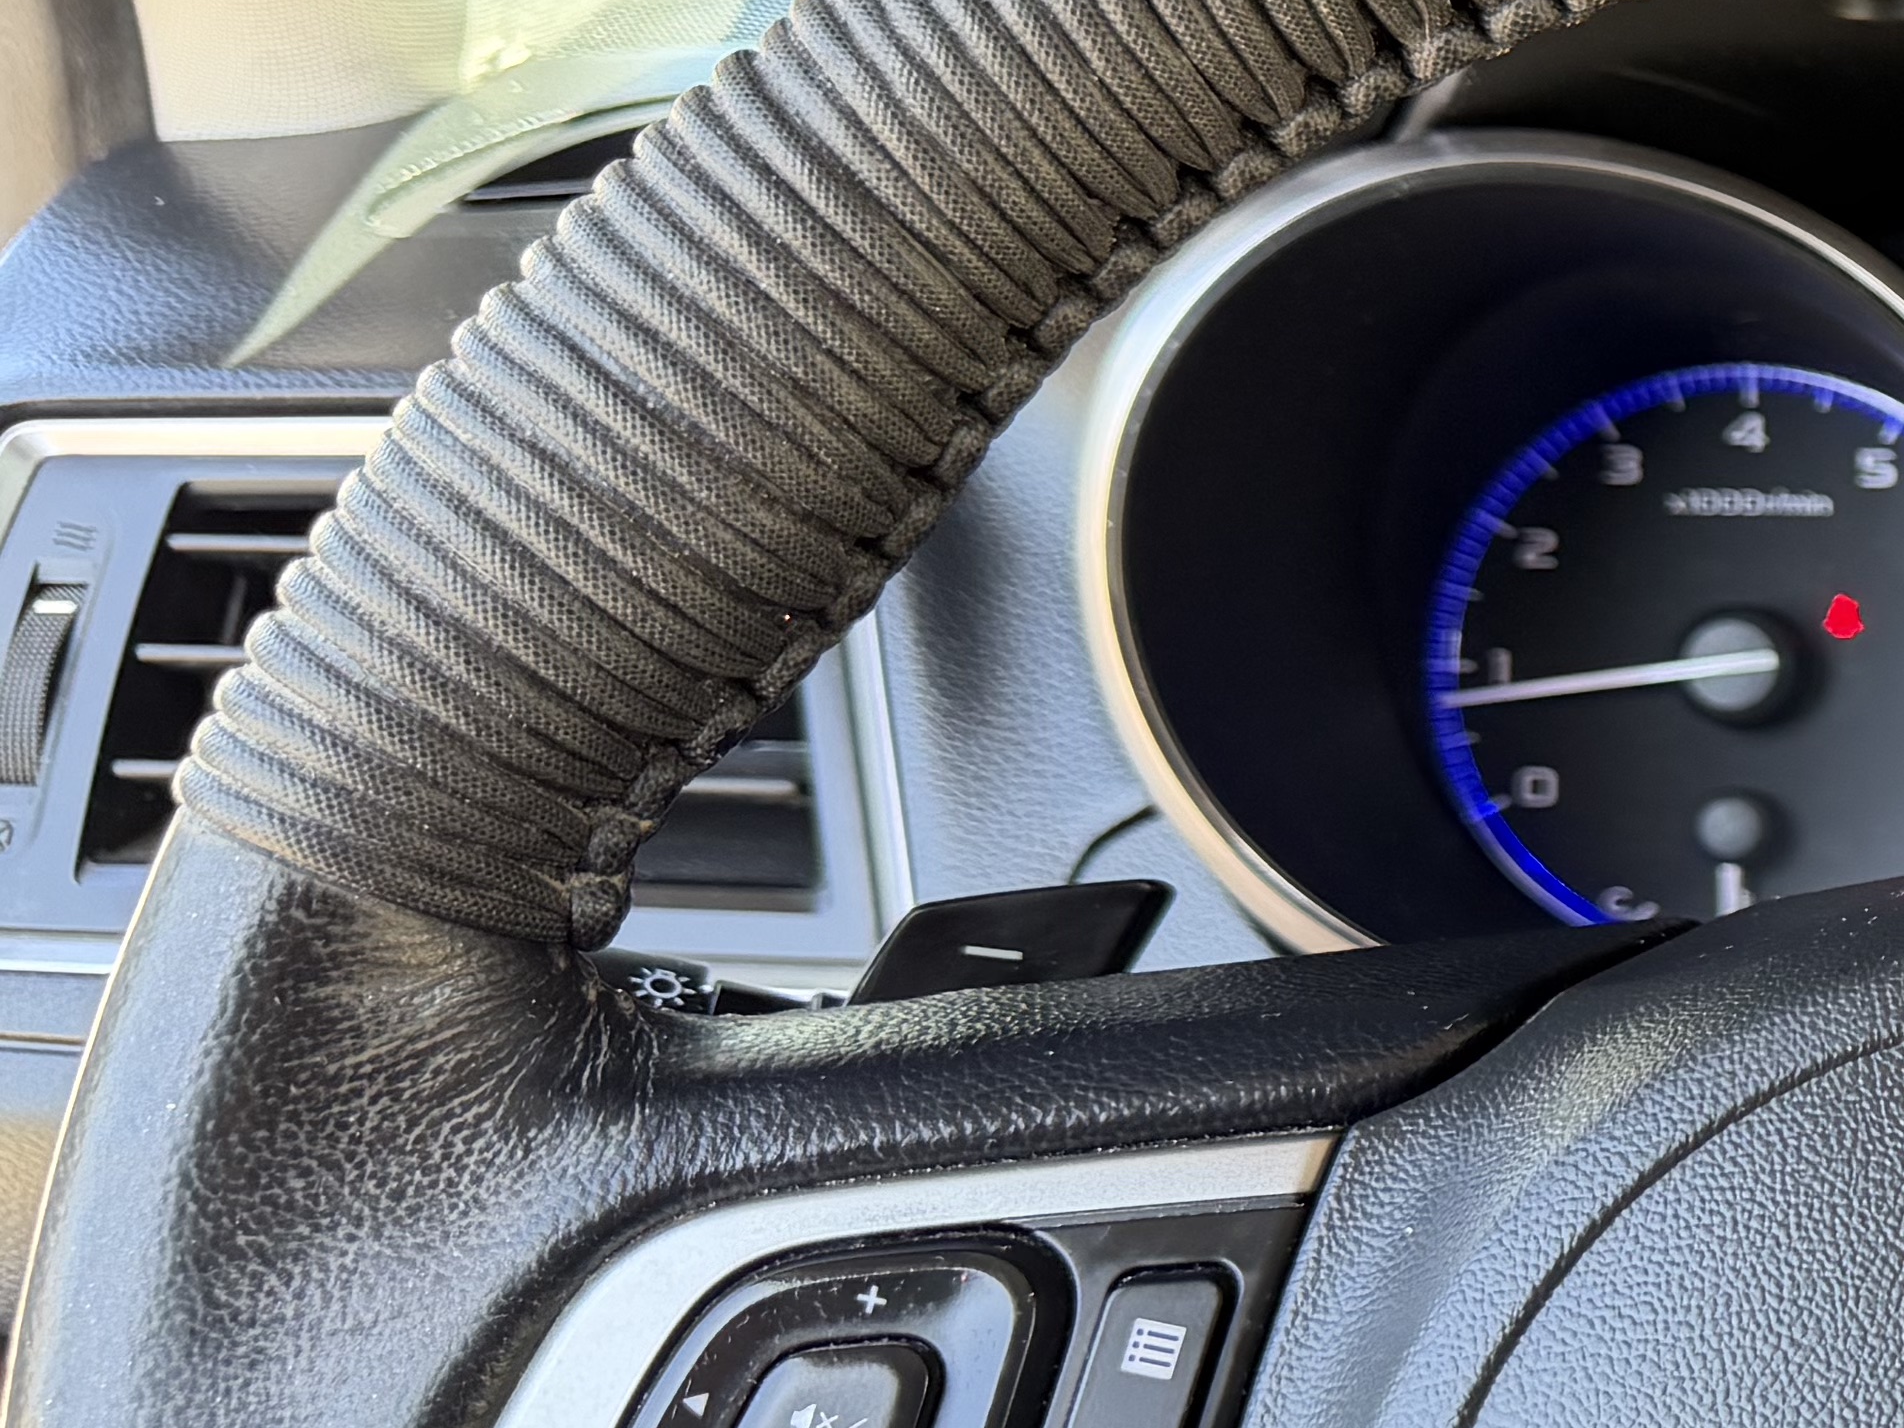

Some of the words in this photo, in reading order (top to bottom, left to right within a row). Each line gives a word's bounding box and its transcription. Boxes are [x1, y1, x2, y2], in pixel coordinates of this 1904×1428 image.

[1724, 412, 1770, 453] 4
[1601, 444, 1643, 486] 3
[1855, 448, 1898, 489] 5
[1513, 527, 1558, 570] 2
[1511, 766, 1560, 808] 0
